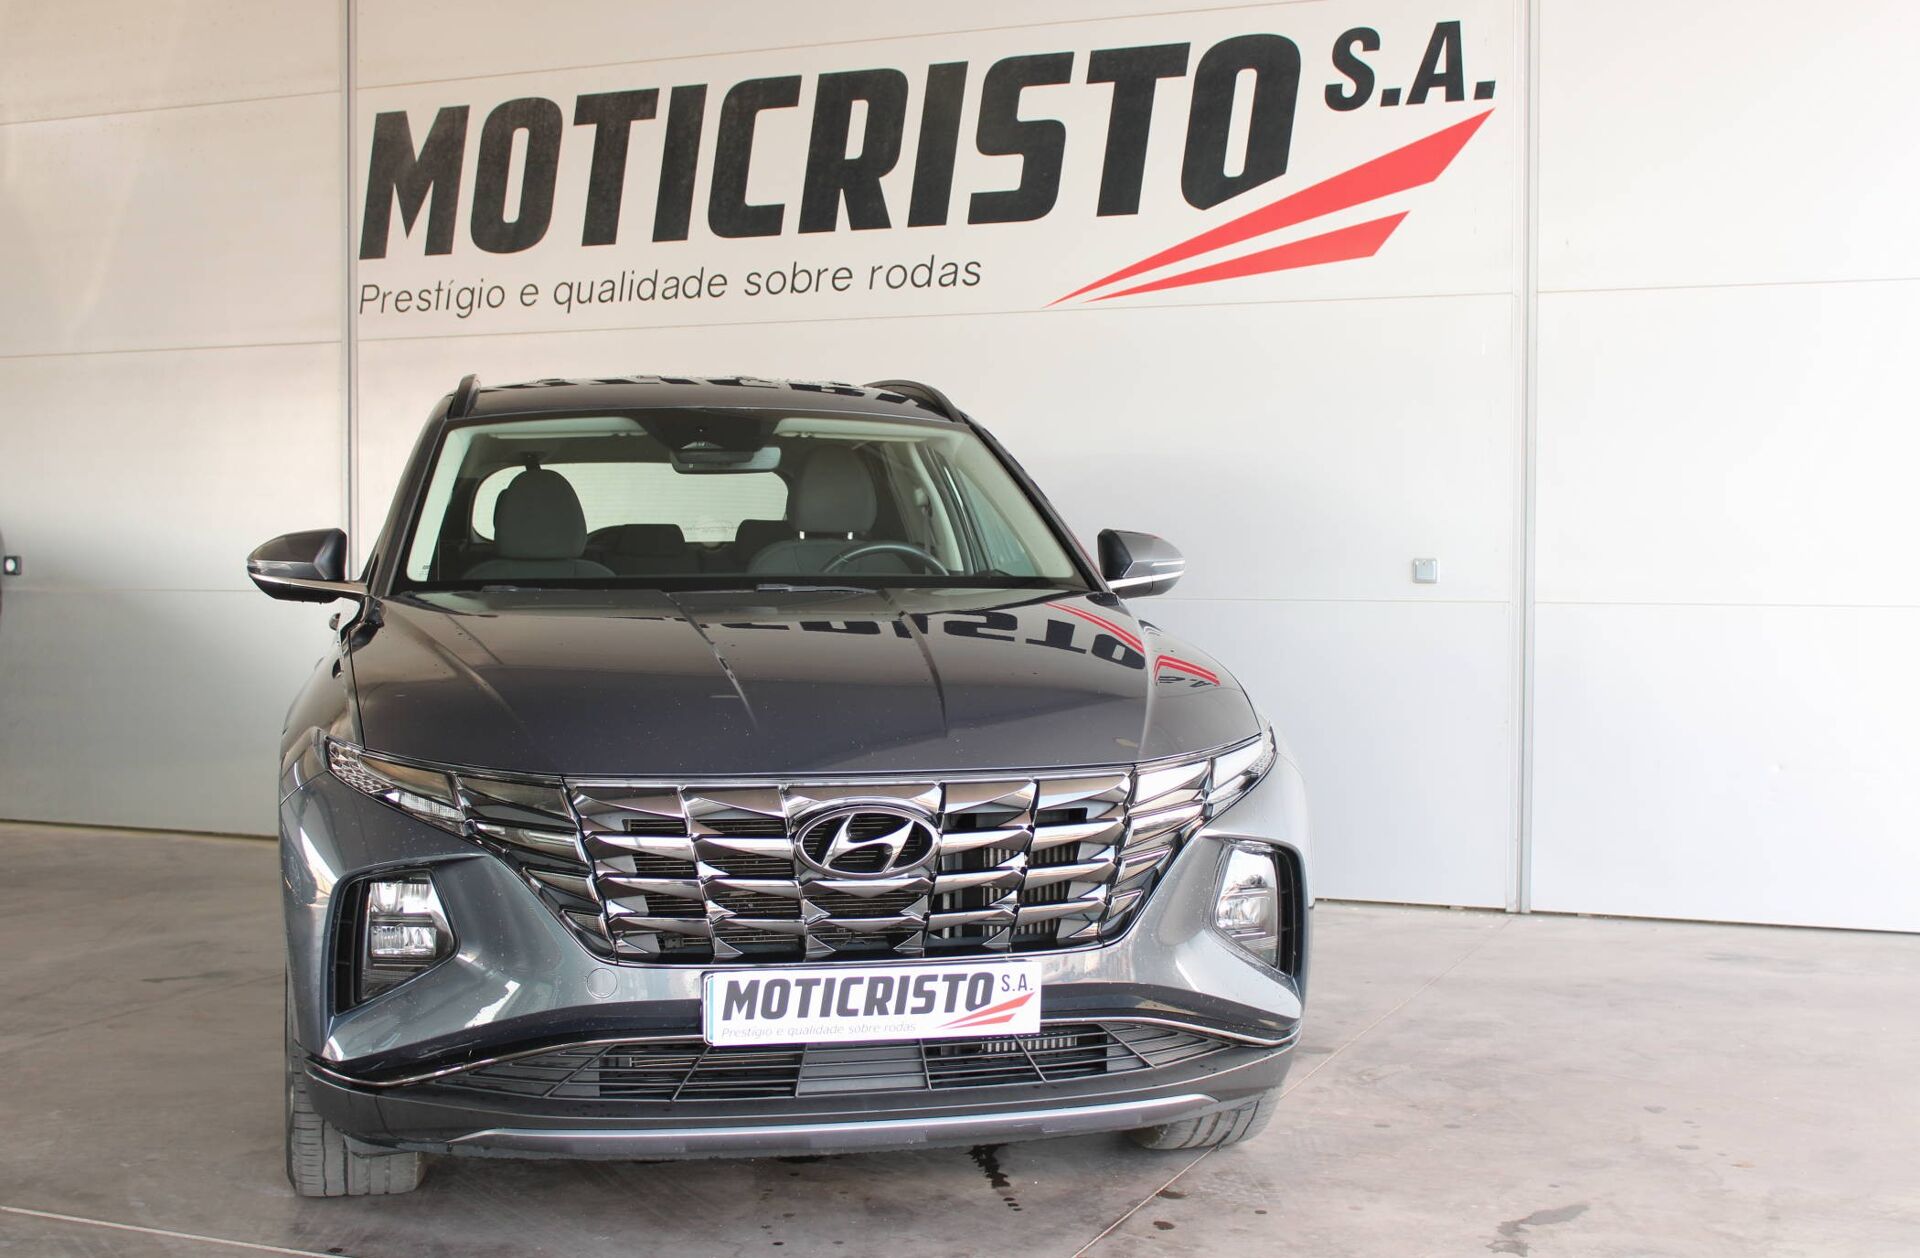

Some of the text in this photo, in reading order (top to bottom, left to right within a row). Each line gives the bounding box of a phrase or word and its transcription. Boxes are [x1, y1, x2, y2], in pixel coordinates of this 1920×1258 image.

[359, 20, 1497, 260] MOTICRISTO S.A.
[358, 253, 982, 319] Prestígio e qualidade sobre rodas
[722, 972, 1034, 1021] MOTICRISTO S.A.
[787, 1023, 845, 1037] qualidade
[848, 1023, 881, 1034] sobre
[883, 1022, 917, 1033] rodas
